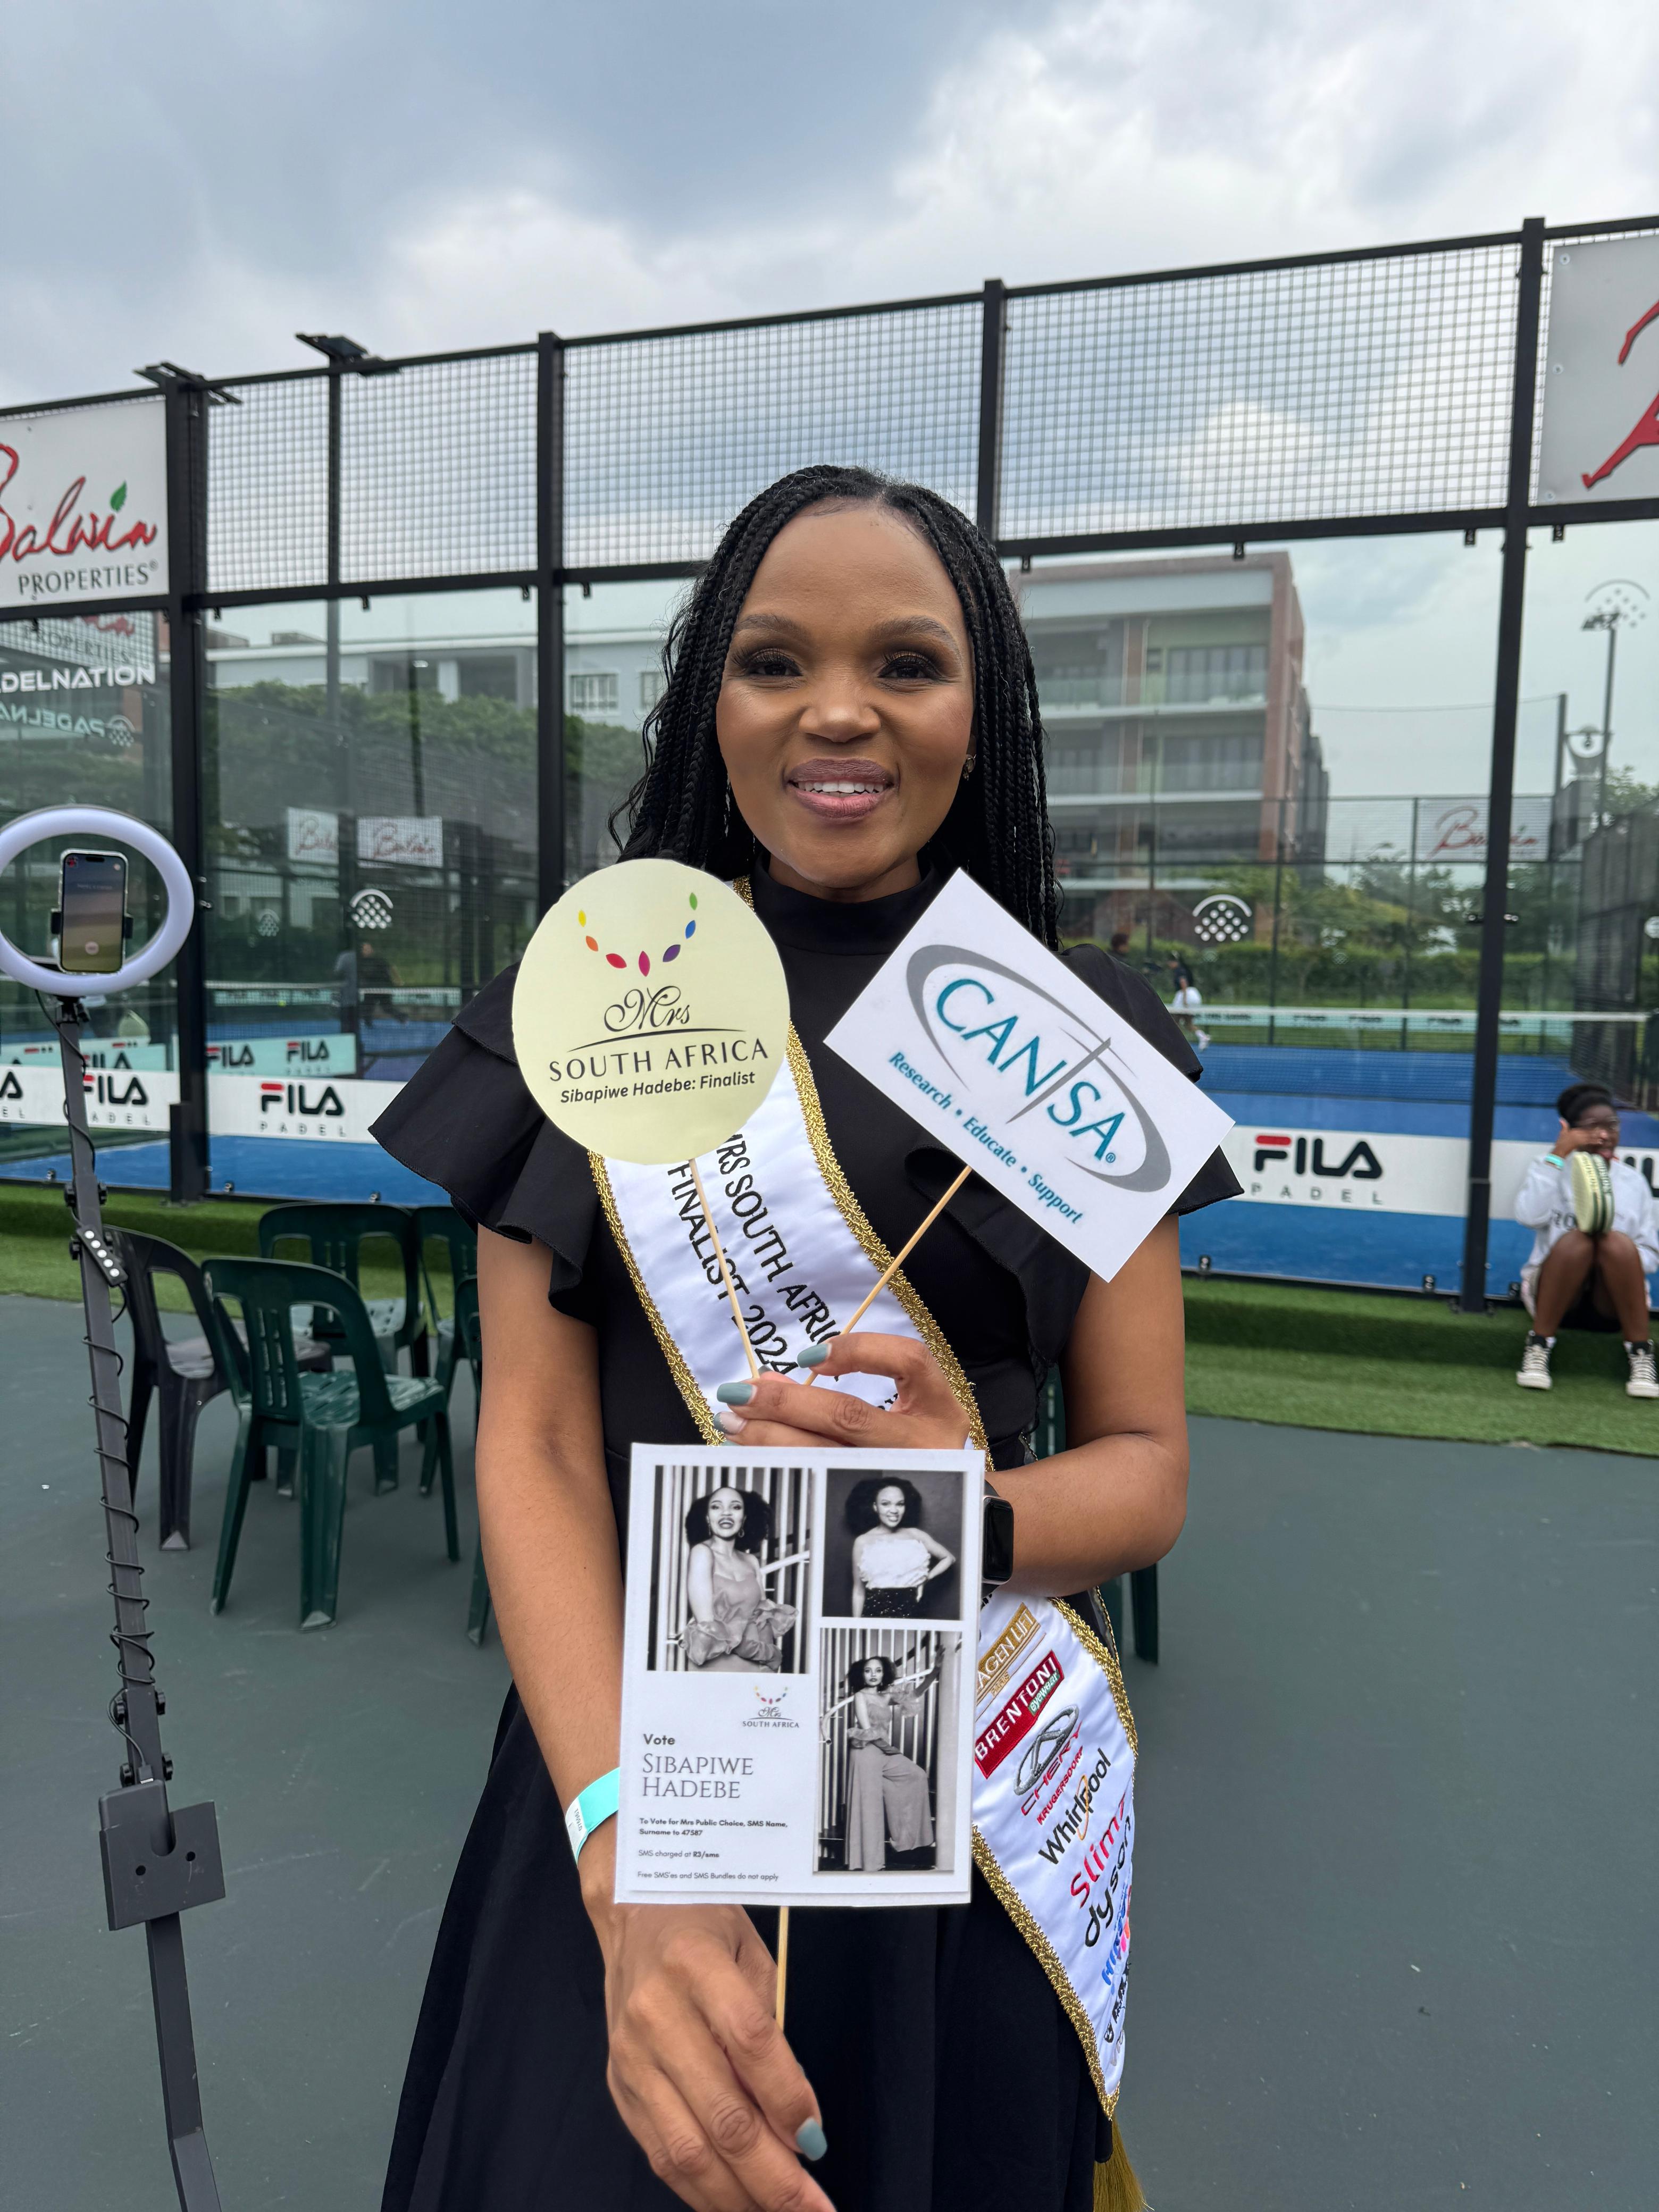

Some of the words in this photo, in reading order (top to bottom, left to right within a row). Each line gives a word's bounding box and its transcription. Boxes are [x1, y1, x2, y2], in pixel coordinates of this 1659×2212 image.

[0, 443, 157, 562] alwin
[604, 986, 690, 1032] Mrs
[287, 1040, 330, 1062] FILA
[549, 1051, 652, 1081] SOUTH
[665, 1038, 769, 1070] AFRICA
[261, 1082, 344, 1116] FILA
[560, 1087, 629, 1103] Sibapiwe
[633, 1077, 696, 1096] Hadebe:
[700, 1071, 756, 1090] Finalist
[91, 1111, 150, 1126] ADEL
[259, 1120, 346, 1137] PADEL
[889, 1051, 952, 1110] Research
[963, 1117, 1017, 1167] Educate
[1028, 1174, 1083, 1224] Support
[1255, 1135, 1382, 1179] FILA
[1251, 1182, 1382, 1205] PADEL
[668, 1163, 750, 1300] FINALIST
[732, 1304, 798, 1375] 2024
[725, 1174, 794, 1282] SOUTH
[776, 1285, 841, 1345] AFRI
[977, 1637, 1016, 1690] AGEN
[1010, 1608, 1034, 1643] LIFT
[975, 1656, 1058, 1761] BRENTONI
[1030, 1672, 1059, 1712] eyewear
[643, 1734, 675, 1745] Vote
[642, 1753, 754, 1775] SIBAPIWE
[1021, 1721, 1083, 1816] CHERY
[1036, 1746, 1083, 1825] KRUGERSDORP
[642, 1777, 741, 1798] HADEBE
[1038, 1747, 1111, 1865] Whirlpool
[655, 1850, 683, 1858] charged
[1085, 1815, 1131, 1948] dyson
